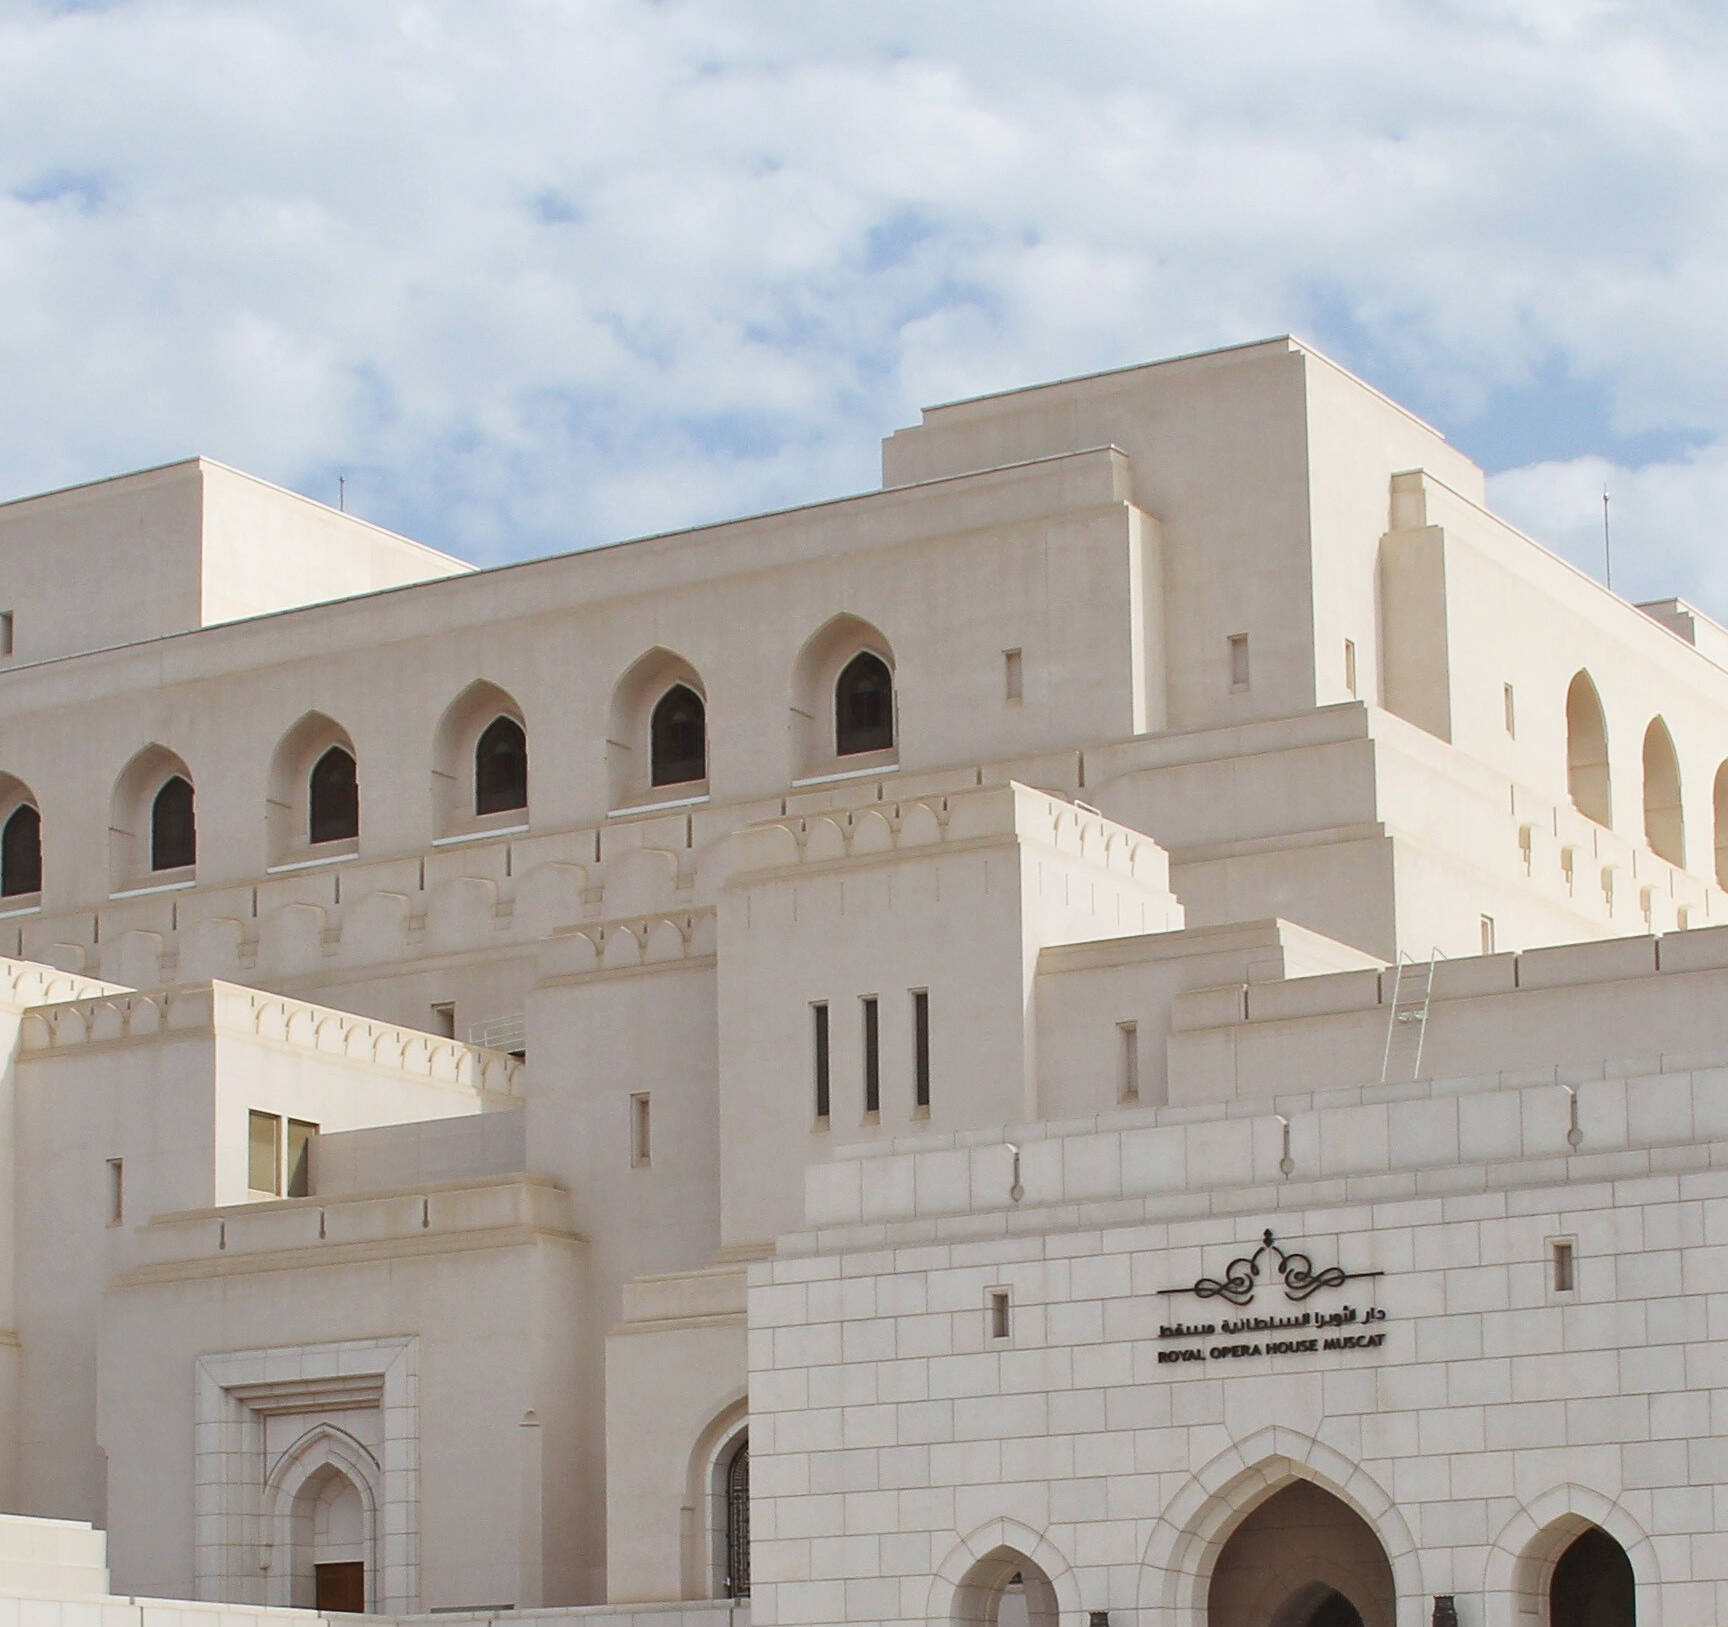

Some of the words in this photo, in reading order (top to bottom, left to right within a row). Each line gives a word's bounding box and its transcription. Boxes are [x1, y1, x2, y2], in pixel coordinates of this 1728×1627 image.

[1221, 1312, 1311, 1334] السلطانية
[1314, 1305, 1357, 1328] الأوبرا
[1361, 1307, 1386, 1324] دار
[1158, 1323, 1215, 1338] مسقط
[1158, 1349, 1206, 1363] ROYAL
[1209, 1344, 1262, 1359] OPERA
[1265, 1339, 1318, 1355] HOUSE
[1323, 1333, 1386, 1350] MUSCAT
